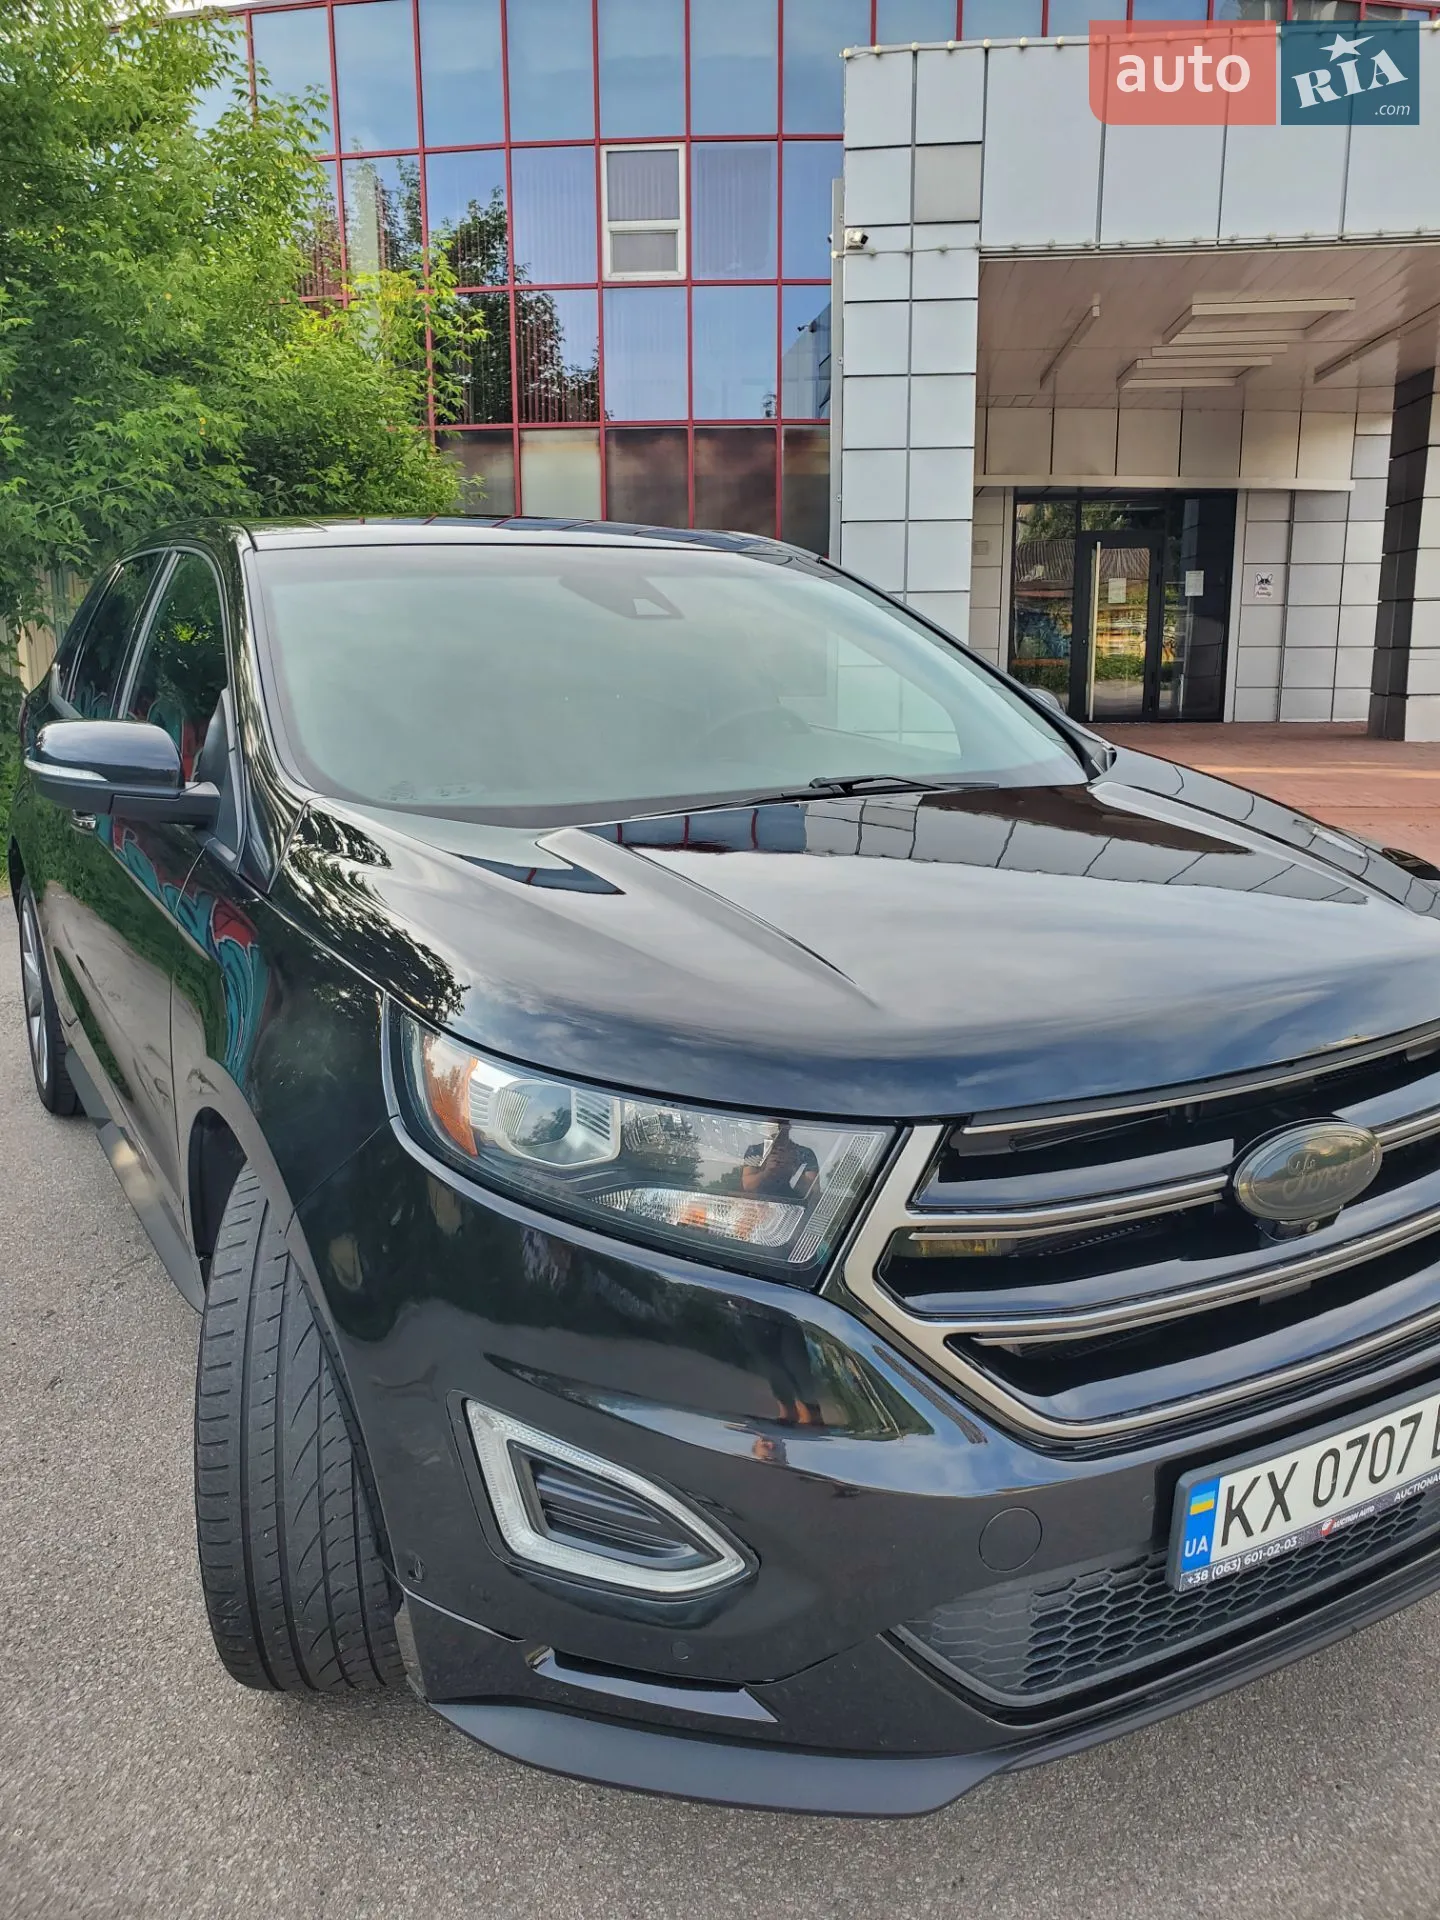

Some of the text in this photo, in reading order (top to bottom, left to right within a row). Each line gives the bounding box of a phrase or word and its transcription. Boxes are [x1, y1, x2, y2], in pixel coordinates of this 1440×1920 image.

[1220, 1461, 1299, 1548] KX
[1312, 1411, 1424, 1508] 0707
[1184, 1535, 1209, 1558] UA
[1187, 1536, 1298, 1585] +38 (063) 601-02-03
